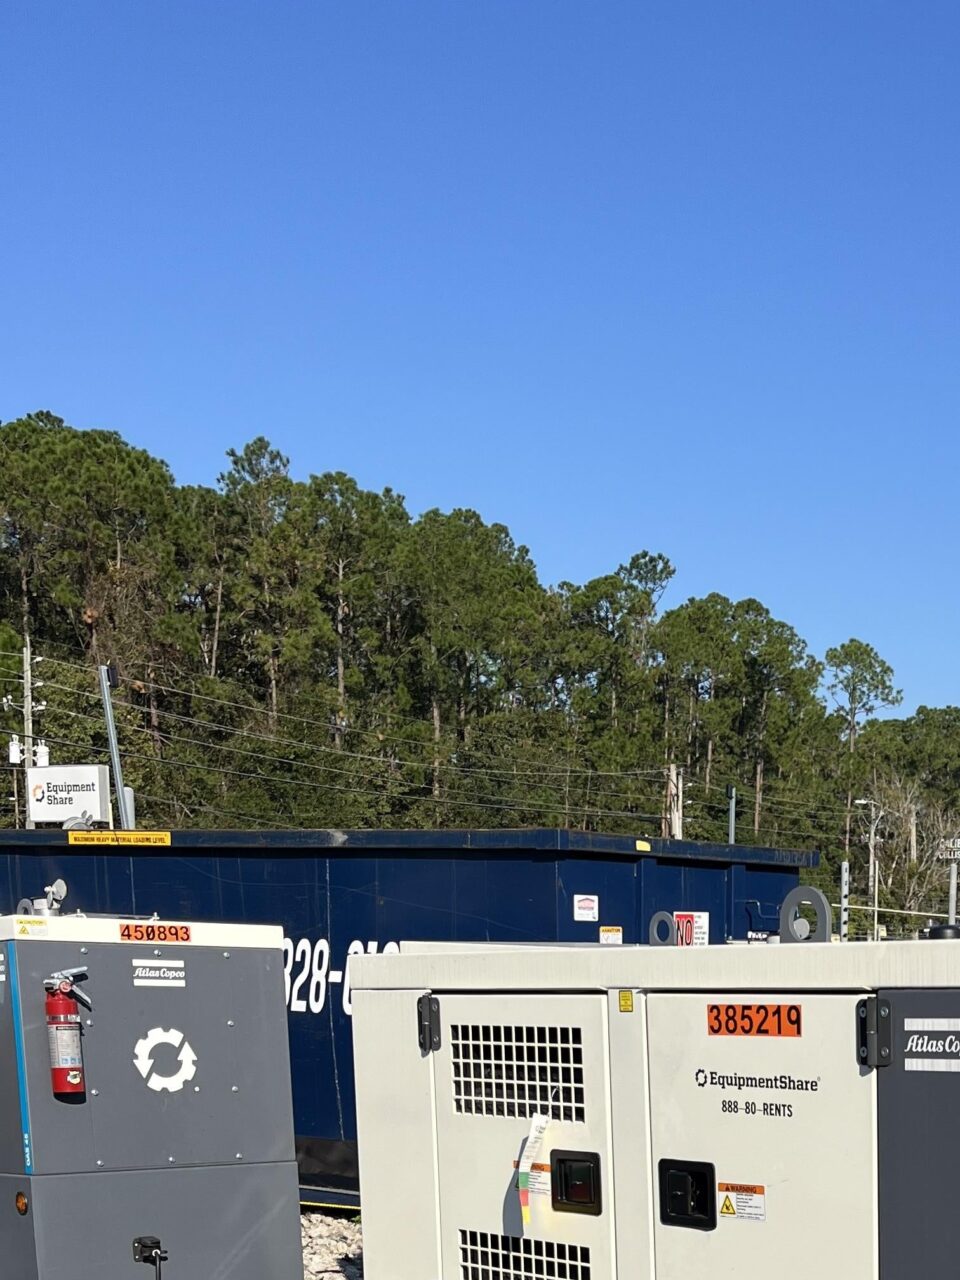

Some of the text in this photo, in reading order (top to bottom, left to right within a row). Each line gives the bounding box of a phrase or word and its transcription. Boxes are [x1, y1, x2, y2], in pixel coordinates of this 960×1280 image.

[46, 782, 96, 795] Equipment
[46, 795, 74, 805] Share
[121, 924, 190, 941] 450893
[676, 919, 694, 945] NO
[133, 967, 186, 979] Atlas Copco
[709, 1004, 801, 1035] 385219
[904, 1034, 944, 1053] Atlas
[709, 1071, 818, 1092] EquipmentShare
[721, 1099, 793, 1118] 888-80-RENTS
[730, 1185, 757, 1194] WARNING
